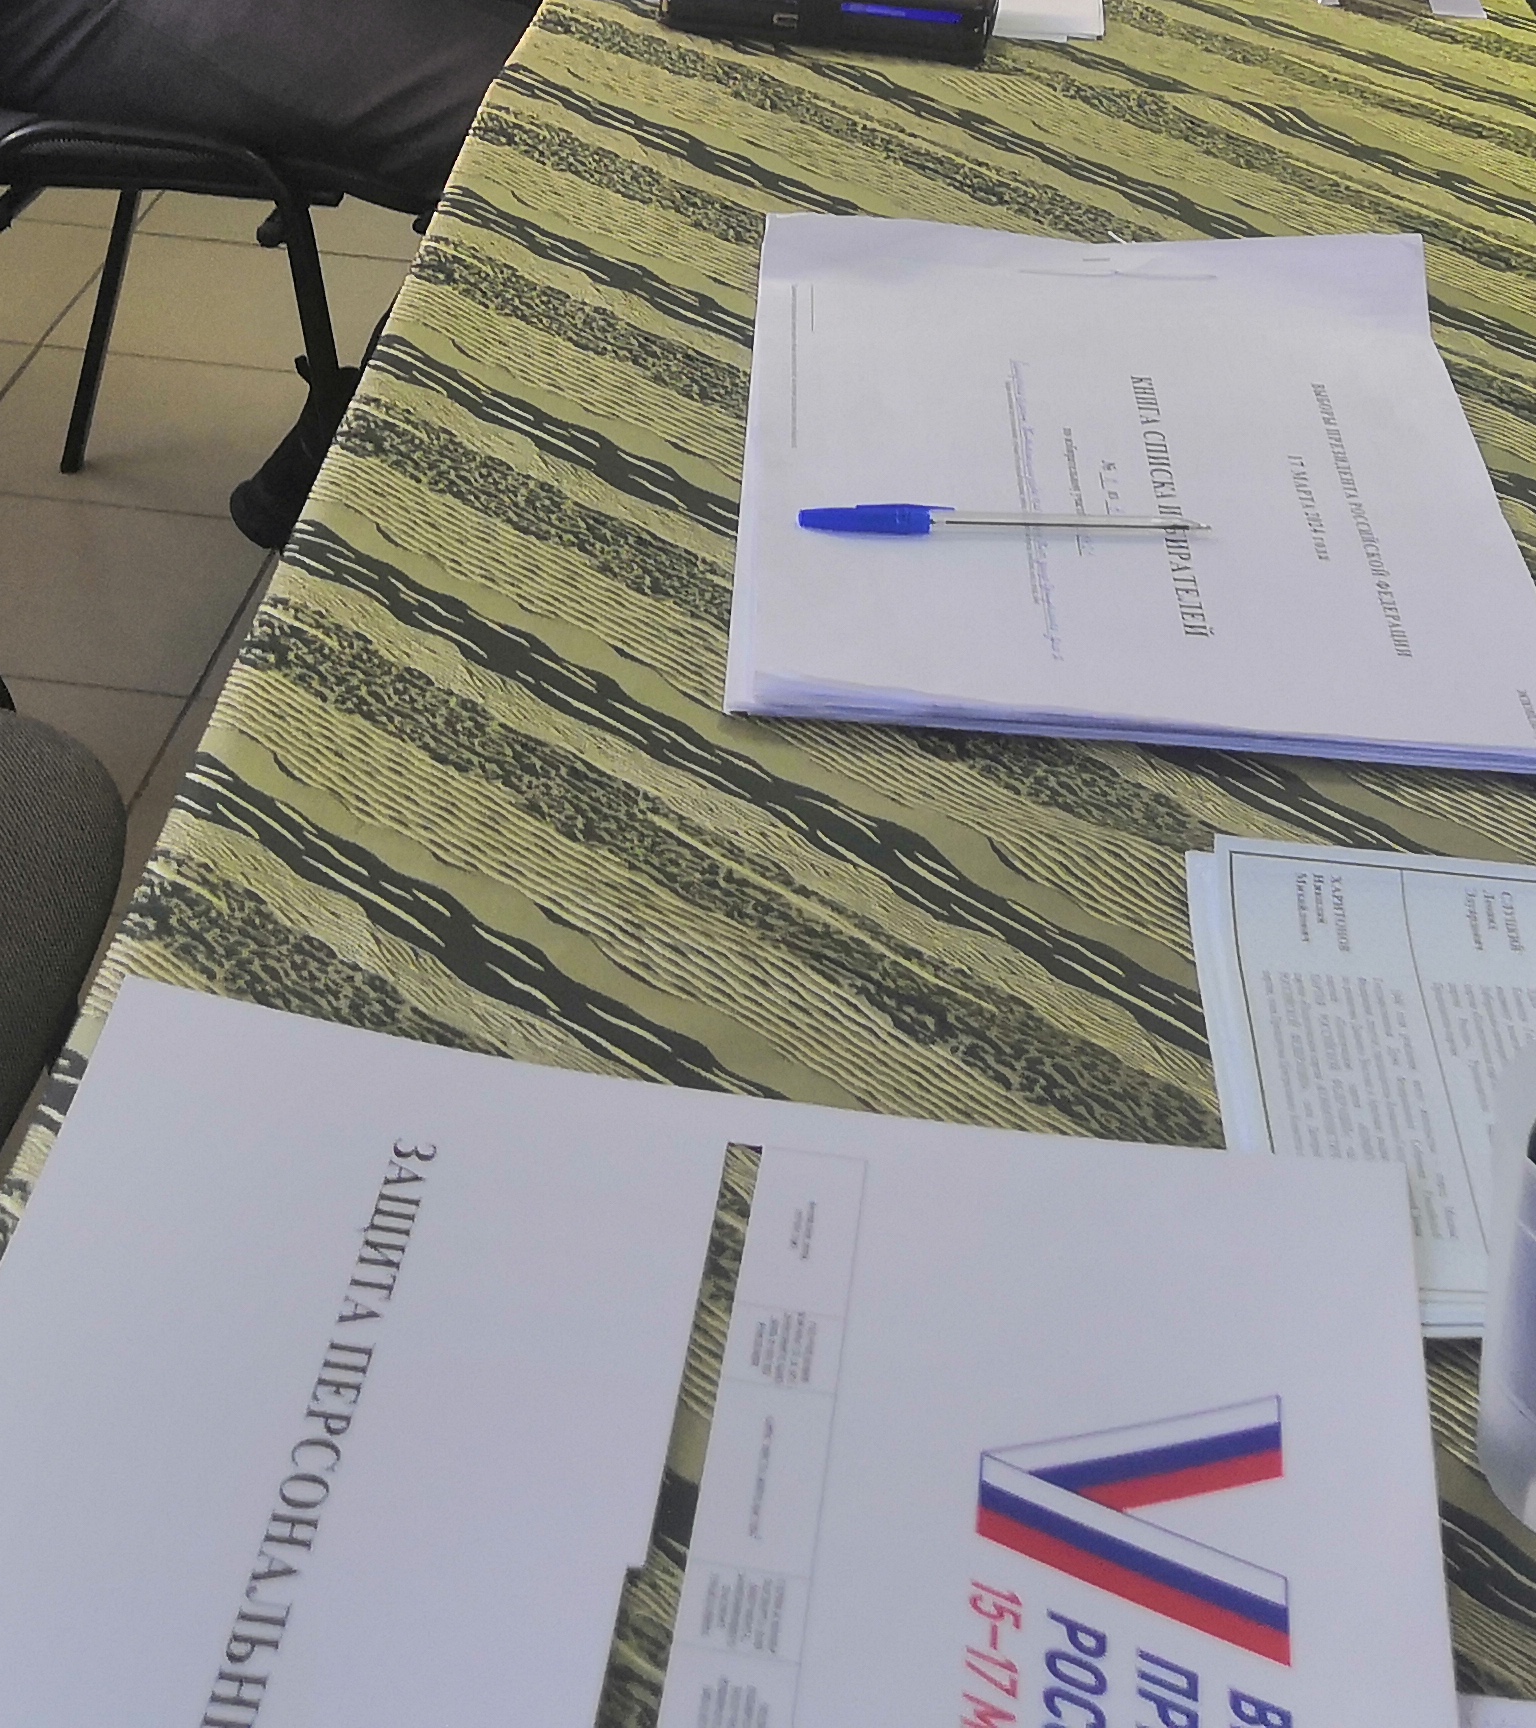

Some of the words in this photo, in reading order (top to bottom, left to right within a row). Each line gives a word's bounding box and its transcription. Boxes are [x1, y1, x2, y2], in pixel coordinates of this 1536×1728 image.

[1129, 374, 1163, 426] КНИГА
[1142, 429, 1176, 500] СПИСКА
[1289, 469, 1315, 510] МАРТА
[1310, 382, 1338, 425] ВЫБОРЫ
[1324, 427, 1358, 500] ПРЕЗИДЕНТА
[1346, 501, 1390, 577] РОССИЙСКОЙ
[1375, 579, 1413, 658] ФЕДЕРАЦИИ
[1156, 503, 1215, 639] ИБИРАТЕЛЕЙ
[1329, 874, 1353, 953] ХАРИТОНОВ
[336, 1138, 438, 1325] ЗАЩИТА
[1042, 1609, 1109, 1728] РОС
[1136, 1648, 1200, 1728] ПР
[1227, 1688, 1293, 1728] В
